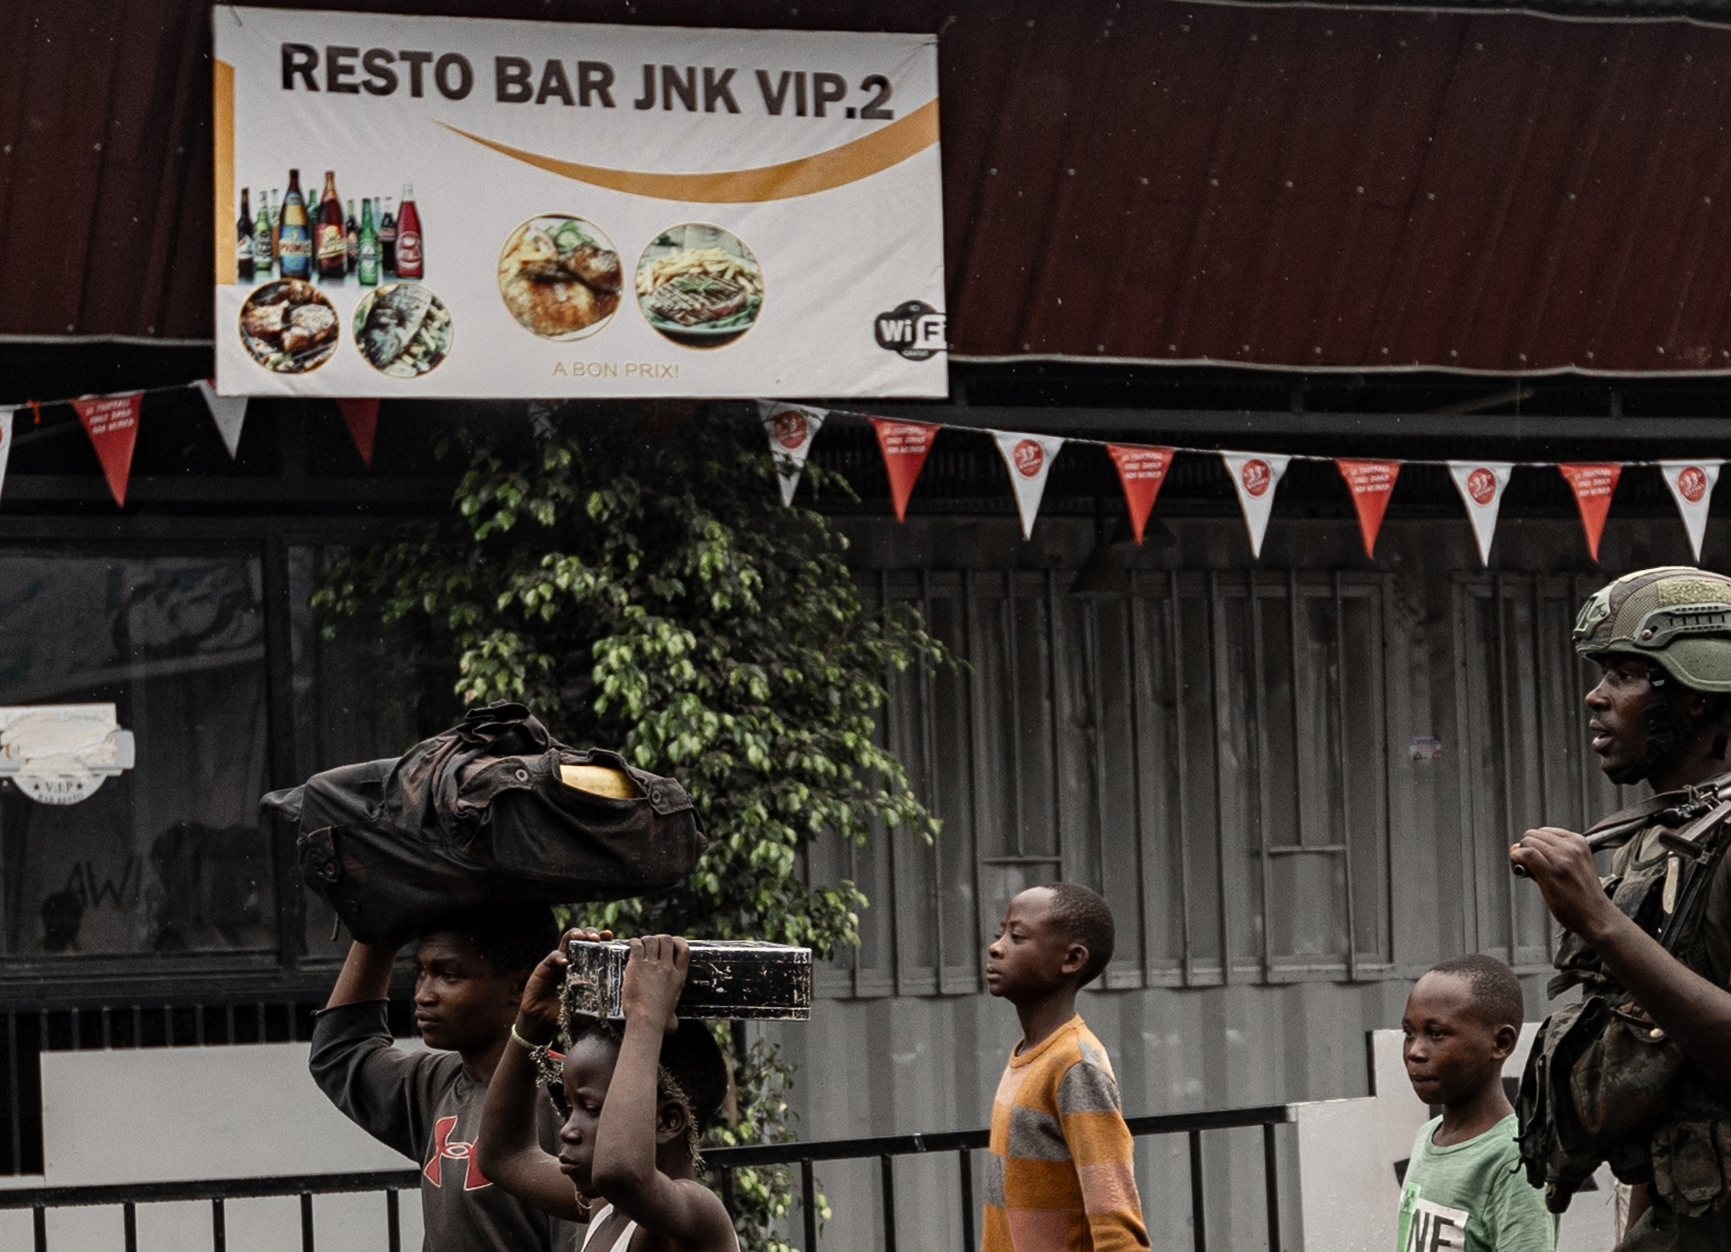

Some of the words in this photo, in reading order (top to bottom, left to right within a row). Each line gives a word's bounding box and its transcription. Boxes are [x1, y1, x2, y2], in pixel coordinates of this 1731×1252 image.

[281, 42, 474, 101] RESTO
[495, 56, 615, 108] BAR
[634, 63, 741, 114] JNK
[755, 68, 895, 120] VIP.2
[552, 360, 568, 376] A
[573, 361, 618, 377] BON
[625, 362, 679, 378] PRIX!
